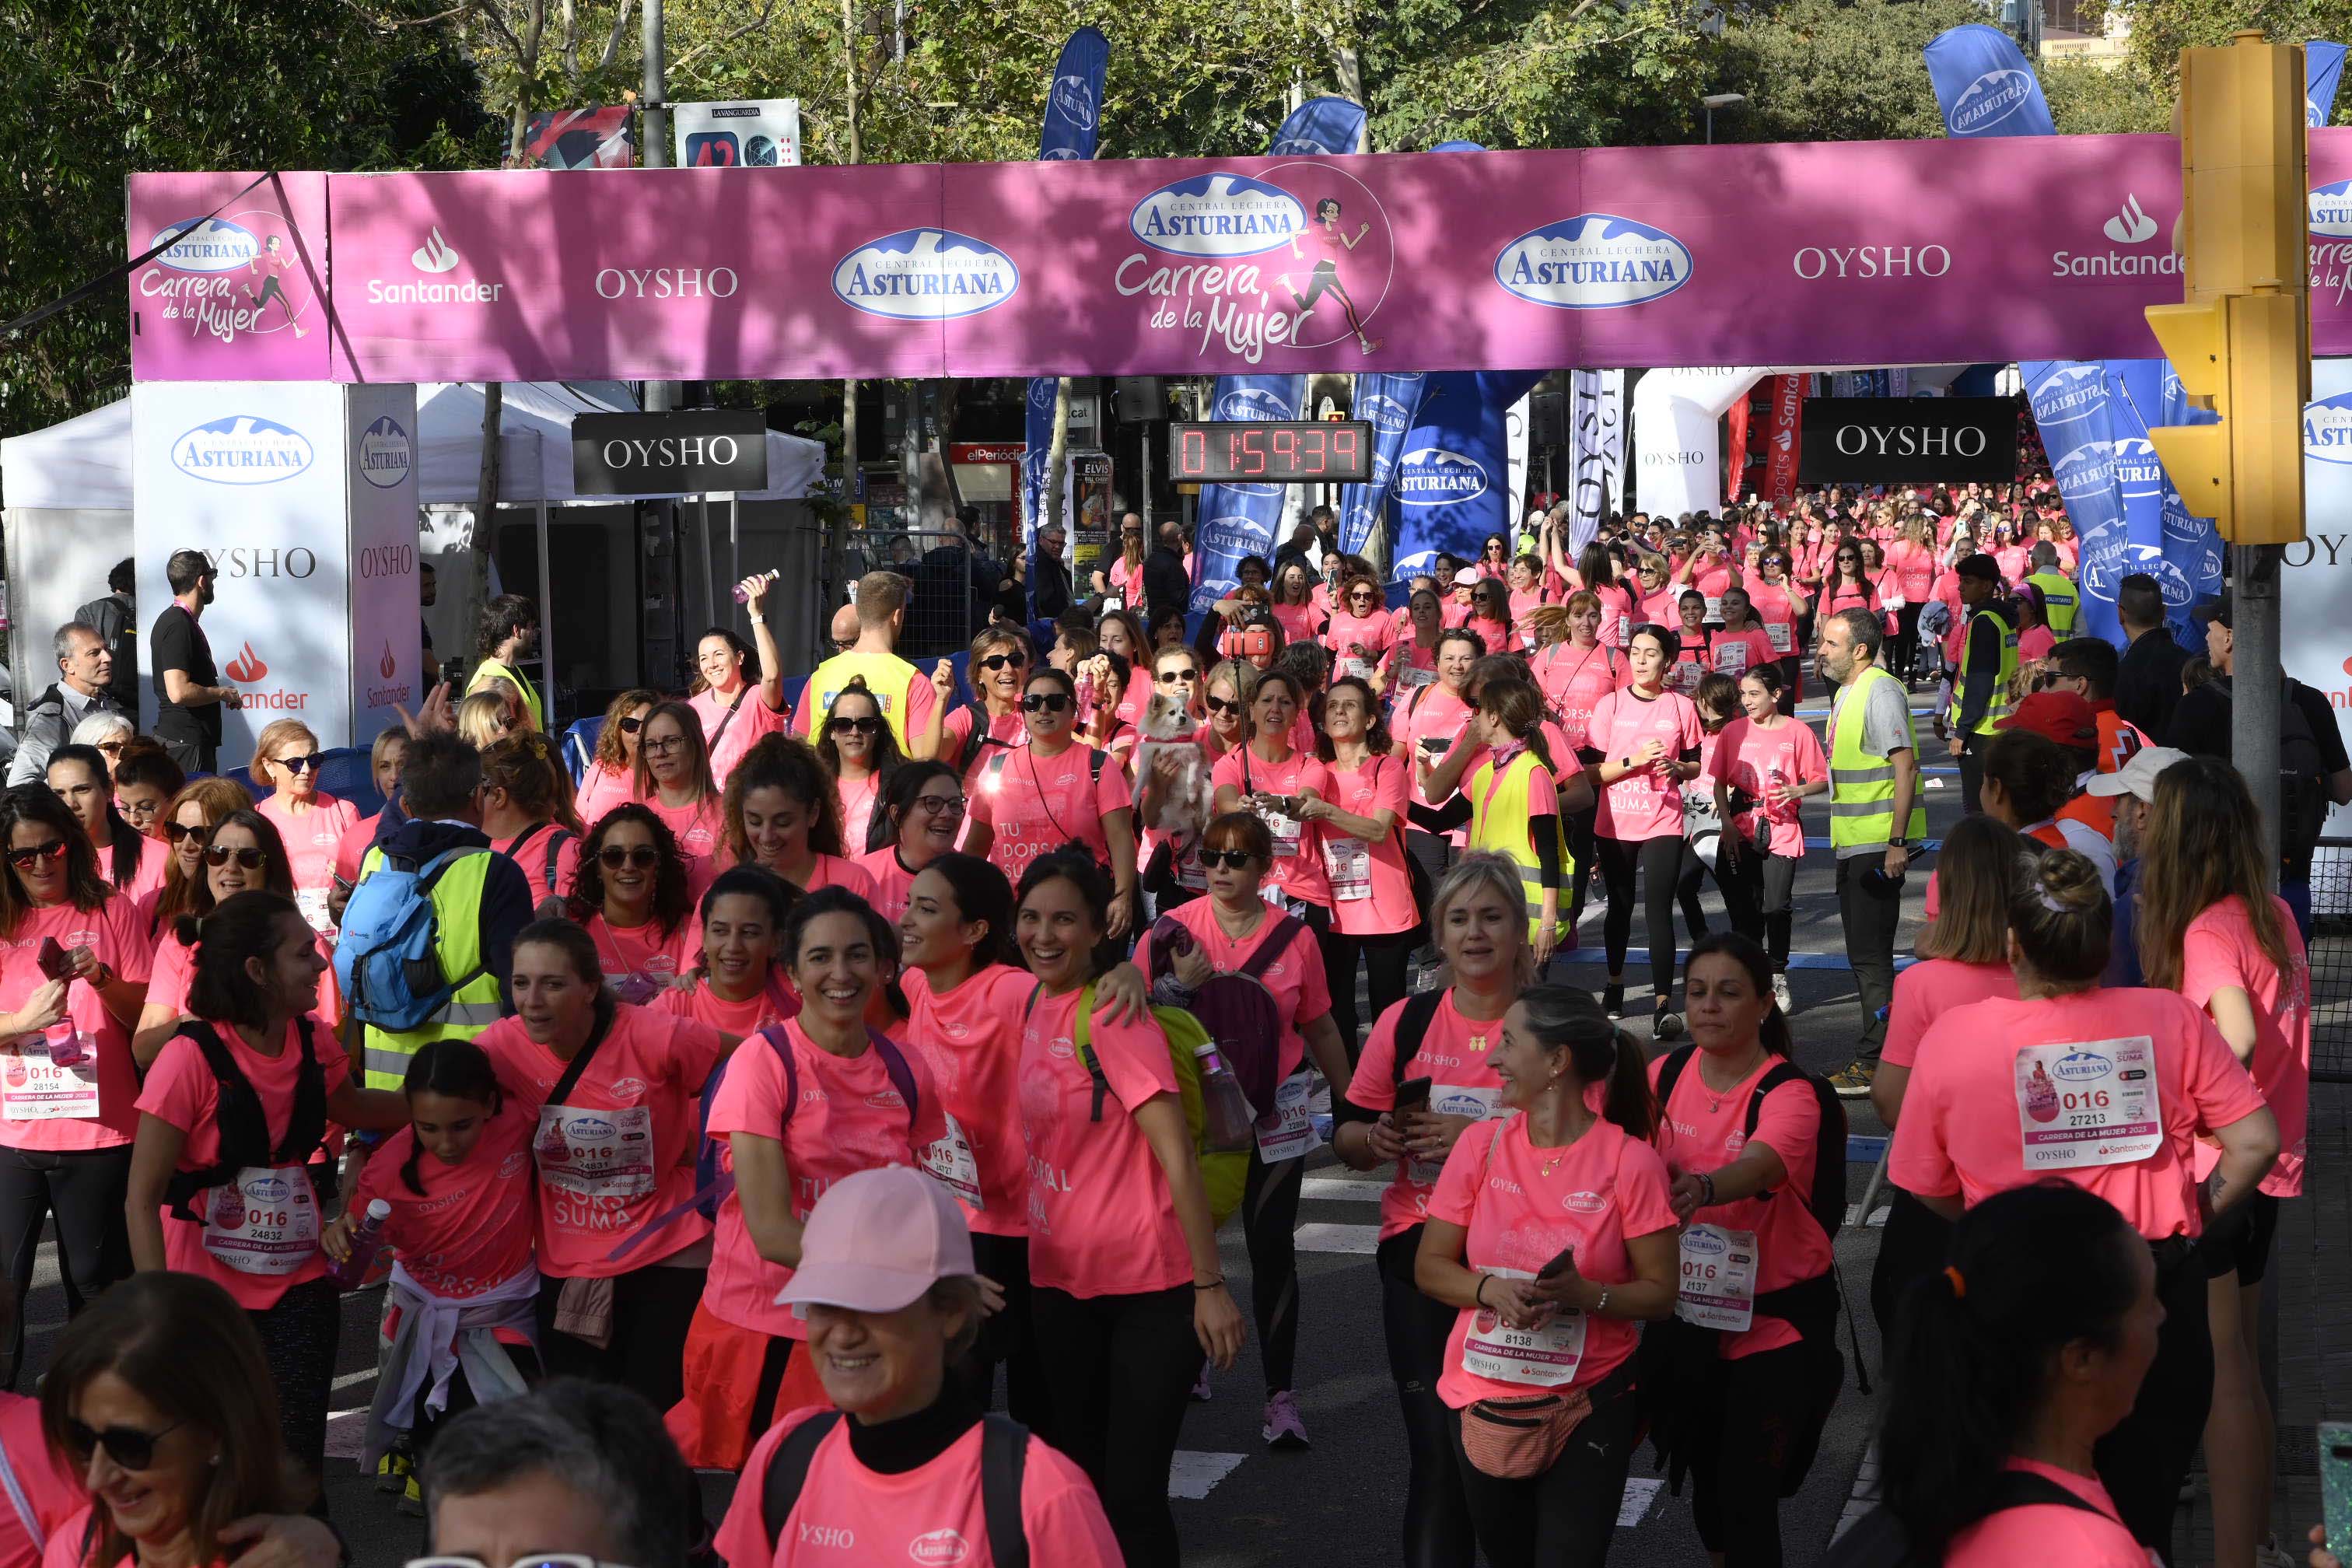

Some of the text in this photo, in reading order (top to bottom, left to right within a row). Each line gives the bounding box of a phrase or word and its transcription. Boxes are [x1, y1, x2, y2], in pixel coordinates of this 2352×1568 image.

[1170, 201, 1288, 212] CENTRAL LECHERA
[1143, 205, 1293, 237] ASTURIANA
[159, 236, 251, 259] ASTURIANA
[1540, 245, 1671, 257] CENTRAL LECHERA
[2308, 243, 2352, 266] arre
[875, 260, 933, 269] CENTRAL
[1510, 250, 1678, 285] ASTURIANA
[1793, 244, 1951, 280] OYSHO
[2053, 250, 2185, 277] Santand
[140, 268, 231, 297] Carrera
[595, 267, 739, 299] OYSHO
[846, 262, 1004, 296] ASTURIANA
[1115, 253, 1260, 296] Carrera
[2308, 266, 2322, 287] e
[2325, 265, 2340, 287] la
[368, 279, 503, 303] Santander
[163, 296, 266, 343] de la Mujer
[1150, 291, 1314, 364] de la Mujer
[1576, 369, 1601, 518] OYSH
[1836, 425, 1986, 457] OYSHO
[183, 442, 303, 467] ASTURIANA
[362, 448, 408, 471] ASTURIANA
[604, 436, 738, 469] OYSHO
[1182, 431, 1357, 474] 01:59:39
[1645, 450, 1703, 466] OYSHO
[1084, 464, 1109, 474] ELVIS
[1392, 474, 1482, 493] ASTURIANA
[1205, 528, 1269, 554] ASTURIANA
[170, 547, 317, 579] YSHO
[361, 544, 412, 579] OYSHO
[240, 689, 308, 710] ander
[367, 683, 411, 709] Santander
[1611, 796, 1650, 810] SUMA
[999, 823, 1020, 837] TU
[1268, 818, 1280, 828] 16
[1003, 864, 1024, 879] SU
[1328, 863, 1347, 872] 016
[1417, 1051, 1460, 1068] OYSHO
[2116, 1054, 2144, 1062] SUMA
[30, 1066, 63, 1080] 016
[2056, 1063, 2109, 1076] ASTURIANA
[33, 1082, 60, 1091] 28154
[1440, 1103, 1482, 1115] ASTURIANA
[2063, 1090, 2110, 1110] 016
[1282, 1104, 1306, 1120] 016
[2070, 1113, 2106, 1126] 27213
[569, 1125, 613, 1136] ASTURIANA
[2038, 1132, 2074, 1142] CARRERA
[2074, 1131, 2085, 1139] DE
[2087, 1129, 2098, 1138] LA
[2098, 1128, 2126, 1137] MUJER
[573, 1146, 613, 1160] 016
[932, 1144, 954, 1164] 016
[2035, 1143, 2152, 1160] OYSHO Santander
[1566, 1197, 1604, 1208] ASTURIANA
[249, 1209, 288, 1227] 016
[553, 1206, 631, 1231] SUMA
[219, 1238, 251, 1249] CARRERA
[250, 1229, 282, 1241] 24832
[1685, 1236, 1722, 1252] ASTURIANA
[214, 1252, 251, 1265] OYSHO
[1682, 1261, 1717, 1279] 016
[1706, 1312, 1742, 1323] Santander
[1505, 1334, 1532, 1346] 8138
[1474, 1343, 1502, 1355] CARRERA
[1525, 1353, 1550, 1361] MUJER
[1470, 1356, 1569, 1379] OYSHO Santander
[800, 1523, 854, 1549] YSHO
